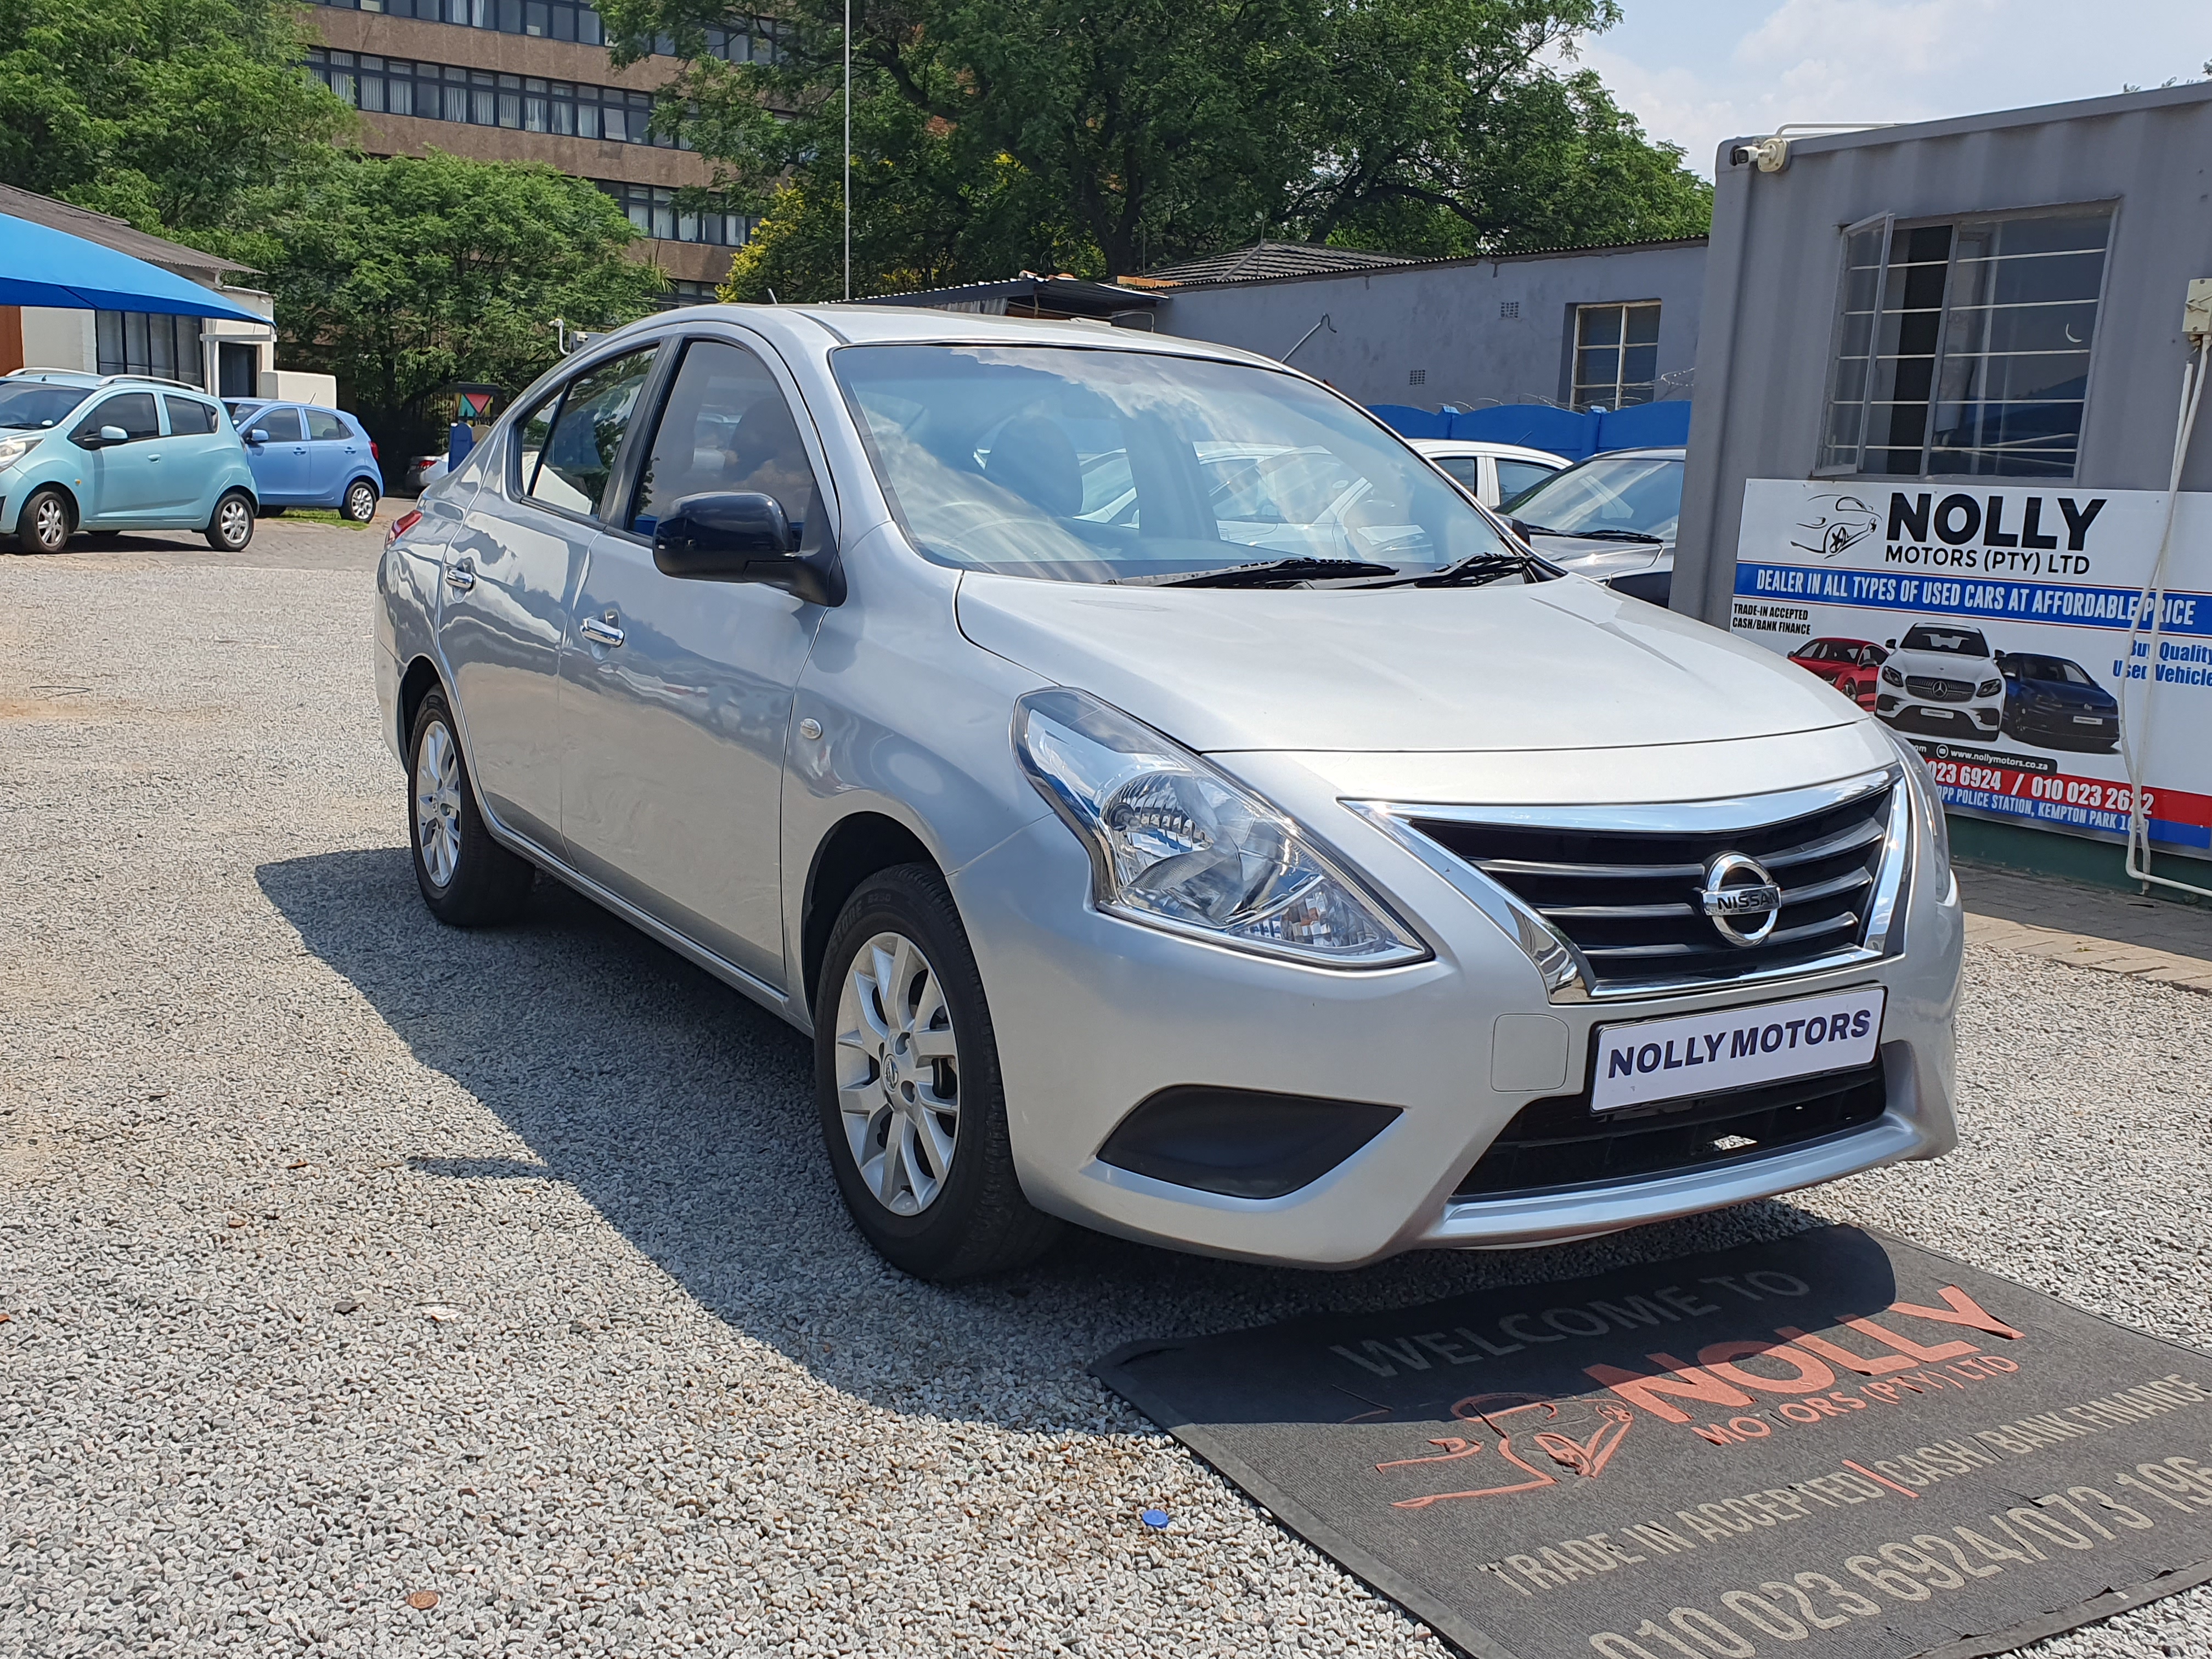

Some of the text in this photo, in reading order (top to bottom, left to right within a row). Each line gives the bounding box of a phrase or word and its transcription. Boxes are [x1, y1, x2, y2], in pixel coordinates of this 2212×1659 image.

[1886, 492, 2108, 551] NOLLY
[1885, 545, 2090, 575] MOTORS (PTY) LTD
[1734, 603, 1808, 620] TRADE-IN ACCEPTED
[1756, 569, 1803, 593] DEALER
[1807, 573, 1821, 594] IN
[1823, 574, 1848, 597] ALL
[1853, 576, 1896, 601] TYPES
[1900, 579, 1919, 602] OF
[1922, 581, 1961, 605] USED
[1965, 584, 2005, 610] CARS
[2007, 588, 2029, 612] AT
[2031, 589, 2138, 620] AFFORDABLE
[1732, 617, 1810, 635] CASH/BANK FINANCE
[1950, 749, 2048, 771] www.nollymotors.co.za
[1956, 789, 1990, 808] POLICE
[1991, 794, 2035, 817] STATION,
[2038, 802, 2087, 824] KEMPTON
[2089, 811, 2118, 830] PARK
[1960, 766, 2001, 791] 6924
[2032, 776, 2063, 800] 010
[2067, 782, 2102, 806] 023
[1717, 891, 1778, 910] NISSAN
[1607, 1009, 1871, 1079] NOLLY MOTORS
[1329, 1270, 1810, 1378] WELCOME TO
[1583, 1283, 2026, 1423] NOLLY
[1859, 1370, 1965, 1404] (PTY)
[1945, 1356, 2019, 1380] LTD
[1480, 1533, 1646, 1596] TRADE
[1620, 1520, 1697, 1555] IN
[1719, 1572, 1882, 1641] 023
